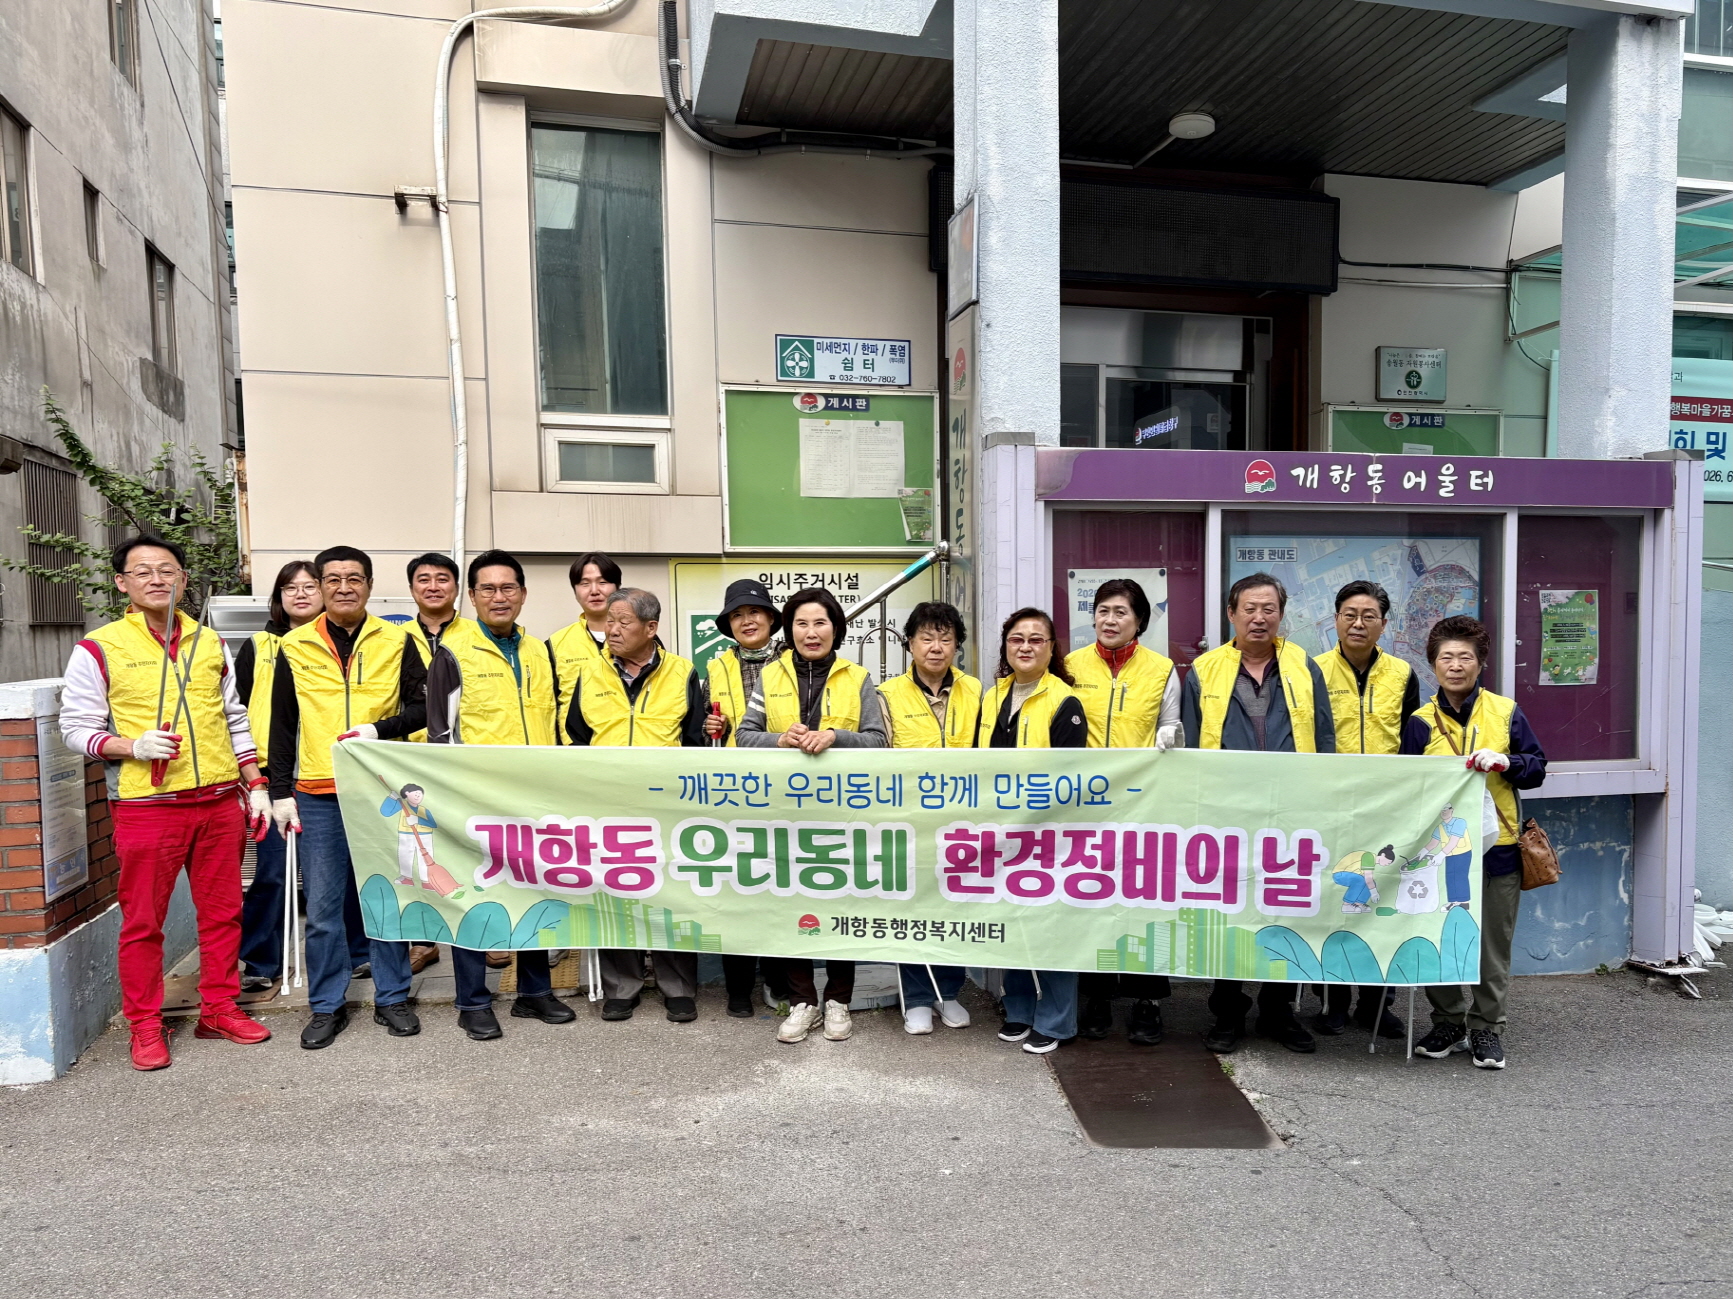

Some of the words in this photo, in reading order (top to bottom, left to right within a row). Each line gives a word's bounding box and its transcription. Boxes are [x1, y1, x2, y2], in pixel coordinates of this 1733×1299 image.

[816, 341, 851, 355] 미세먼지
[861, 342, 879, 356] 한파
[889, 344, 906, 358] 폭염
[838, 375, 897, 384] 032-760-7802
[1671, 371, 1684, 383] 과
[827, 397, 867, 410] 게시판
[1670, 401, 1733, 418] 행복마을가꿈
[1411, 415, 1443, 426] 게시판
[1705, 431, 1728, 461] 및
[1289, 463, 1386, 494] 개항동
[1402, 462, 1495, 498] 어울터
[1703, 469, 1724, 483] 026.
[1267, 549, 1296, 561] 관내도
[757, 572, 860, 591] 임시주거시설
[678, 772, 773, 810] 깨끗한
[785, 772, 904, 810] 우리동네
[917, 772, 979, 810] 함께
[993, 772, 1113, 811] 만들어요
[473, 822, 658, 892] 개항동
[676, 823, 908, 893] 우리동네
[942, 826, 1240, 905] 환경정비의
[1263, 836, 1322, 909] 날
[830, 915, 1006, 944] 개항동행정복지센터
